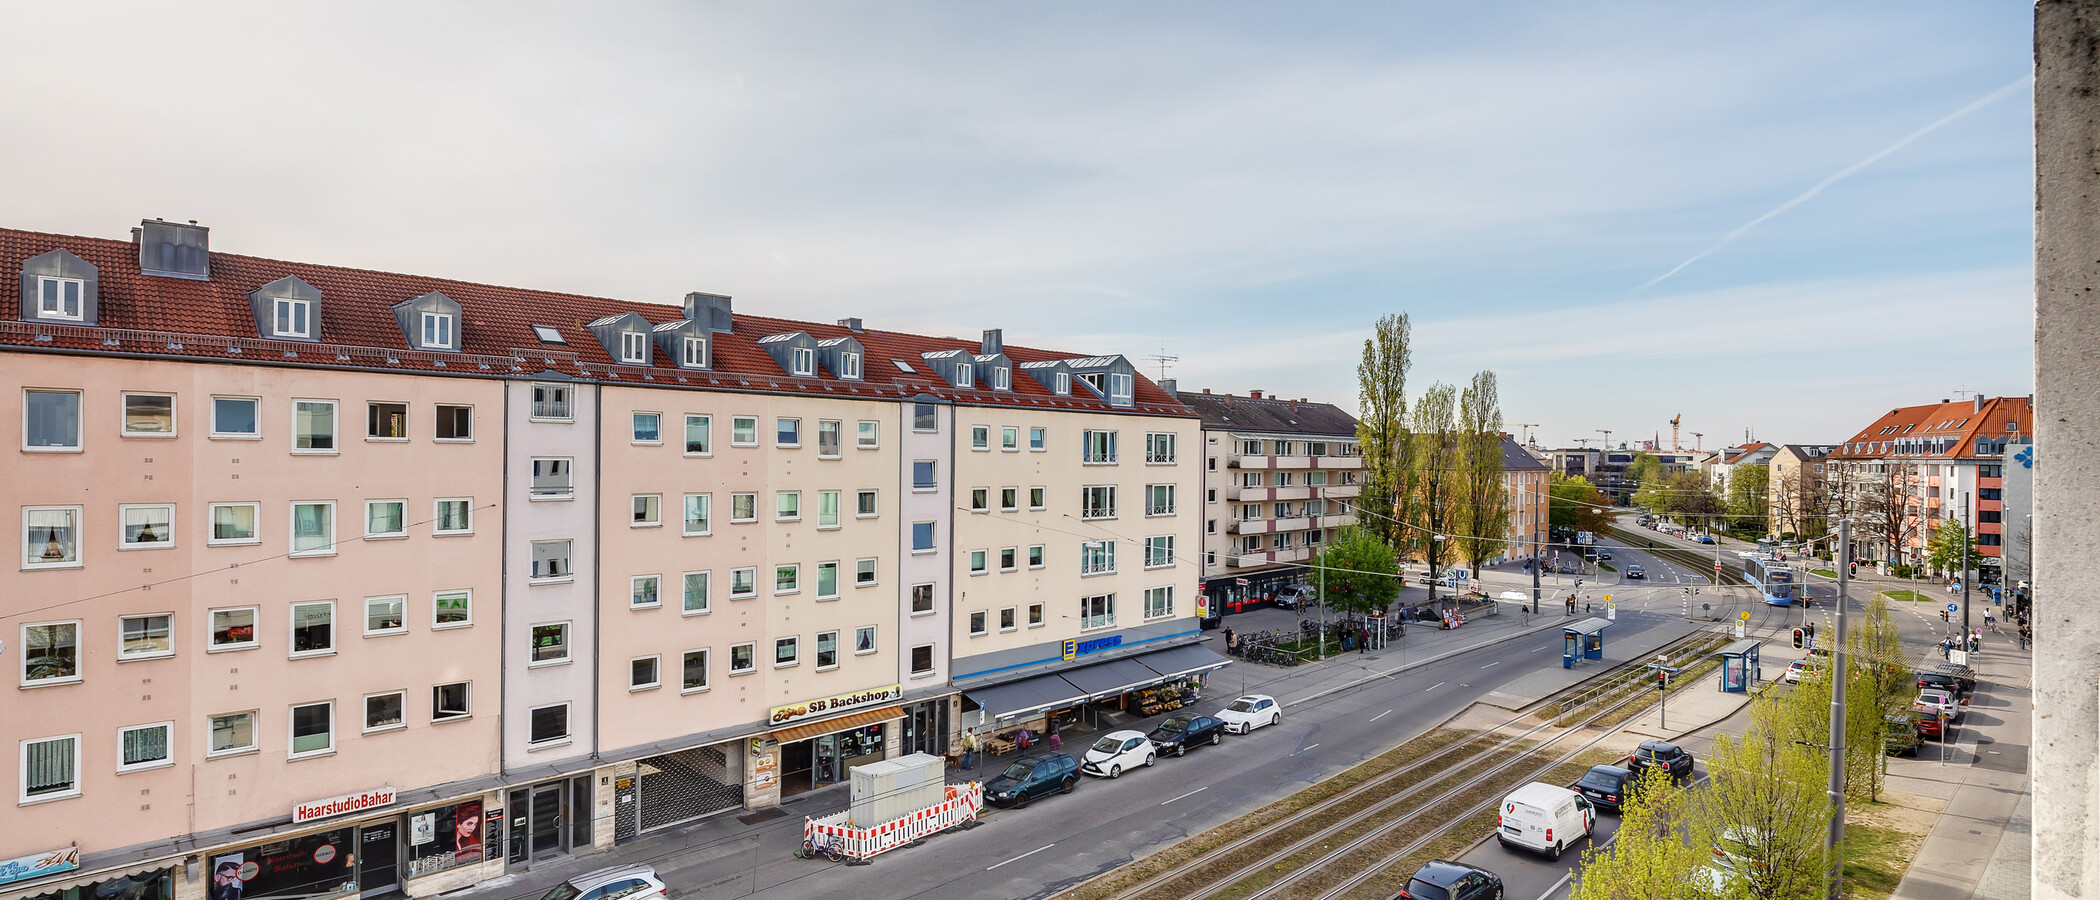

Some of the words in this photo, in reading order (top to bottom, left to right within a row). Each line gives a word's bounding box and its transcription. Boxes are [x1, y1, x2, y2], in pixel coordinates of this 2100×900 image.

[1447, 570, 1456, 578] S
[809, 701, 827, 713] SB
[829, 690, 889, 709] Backshop
[298, 791, 393, 820] HaarstudioBahar
[315, 850, 335, 858] HERREN
[237, 867, 258, 876] DAMEN
